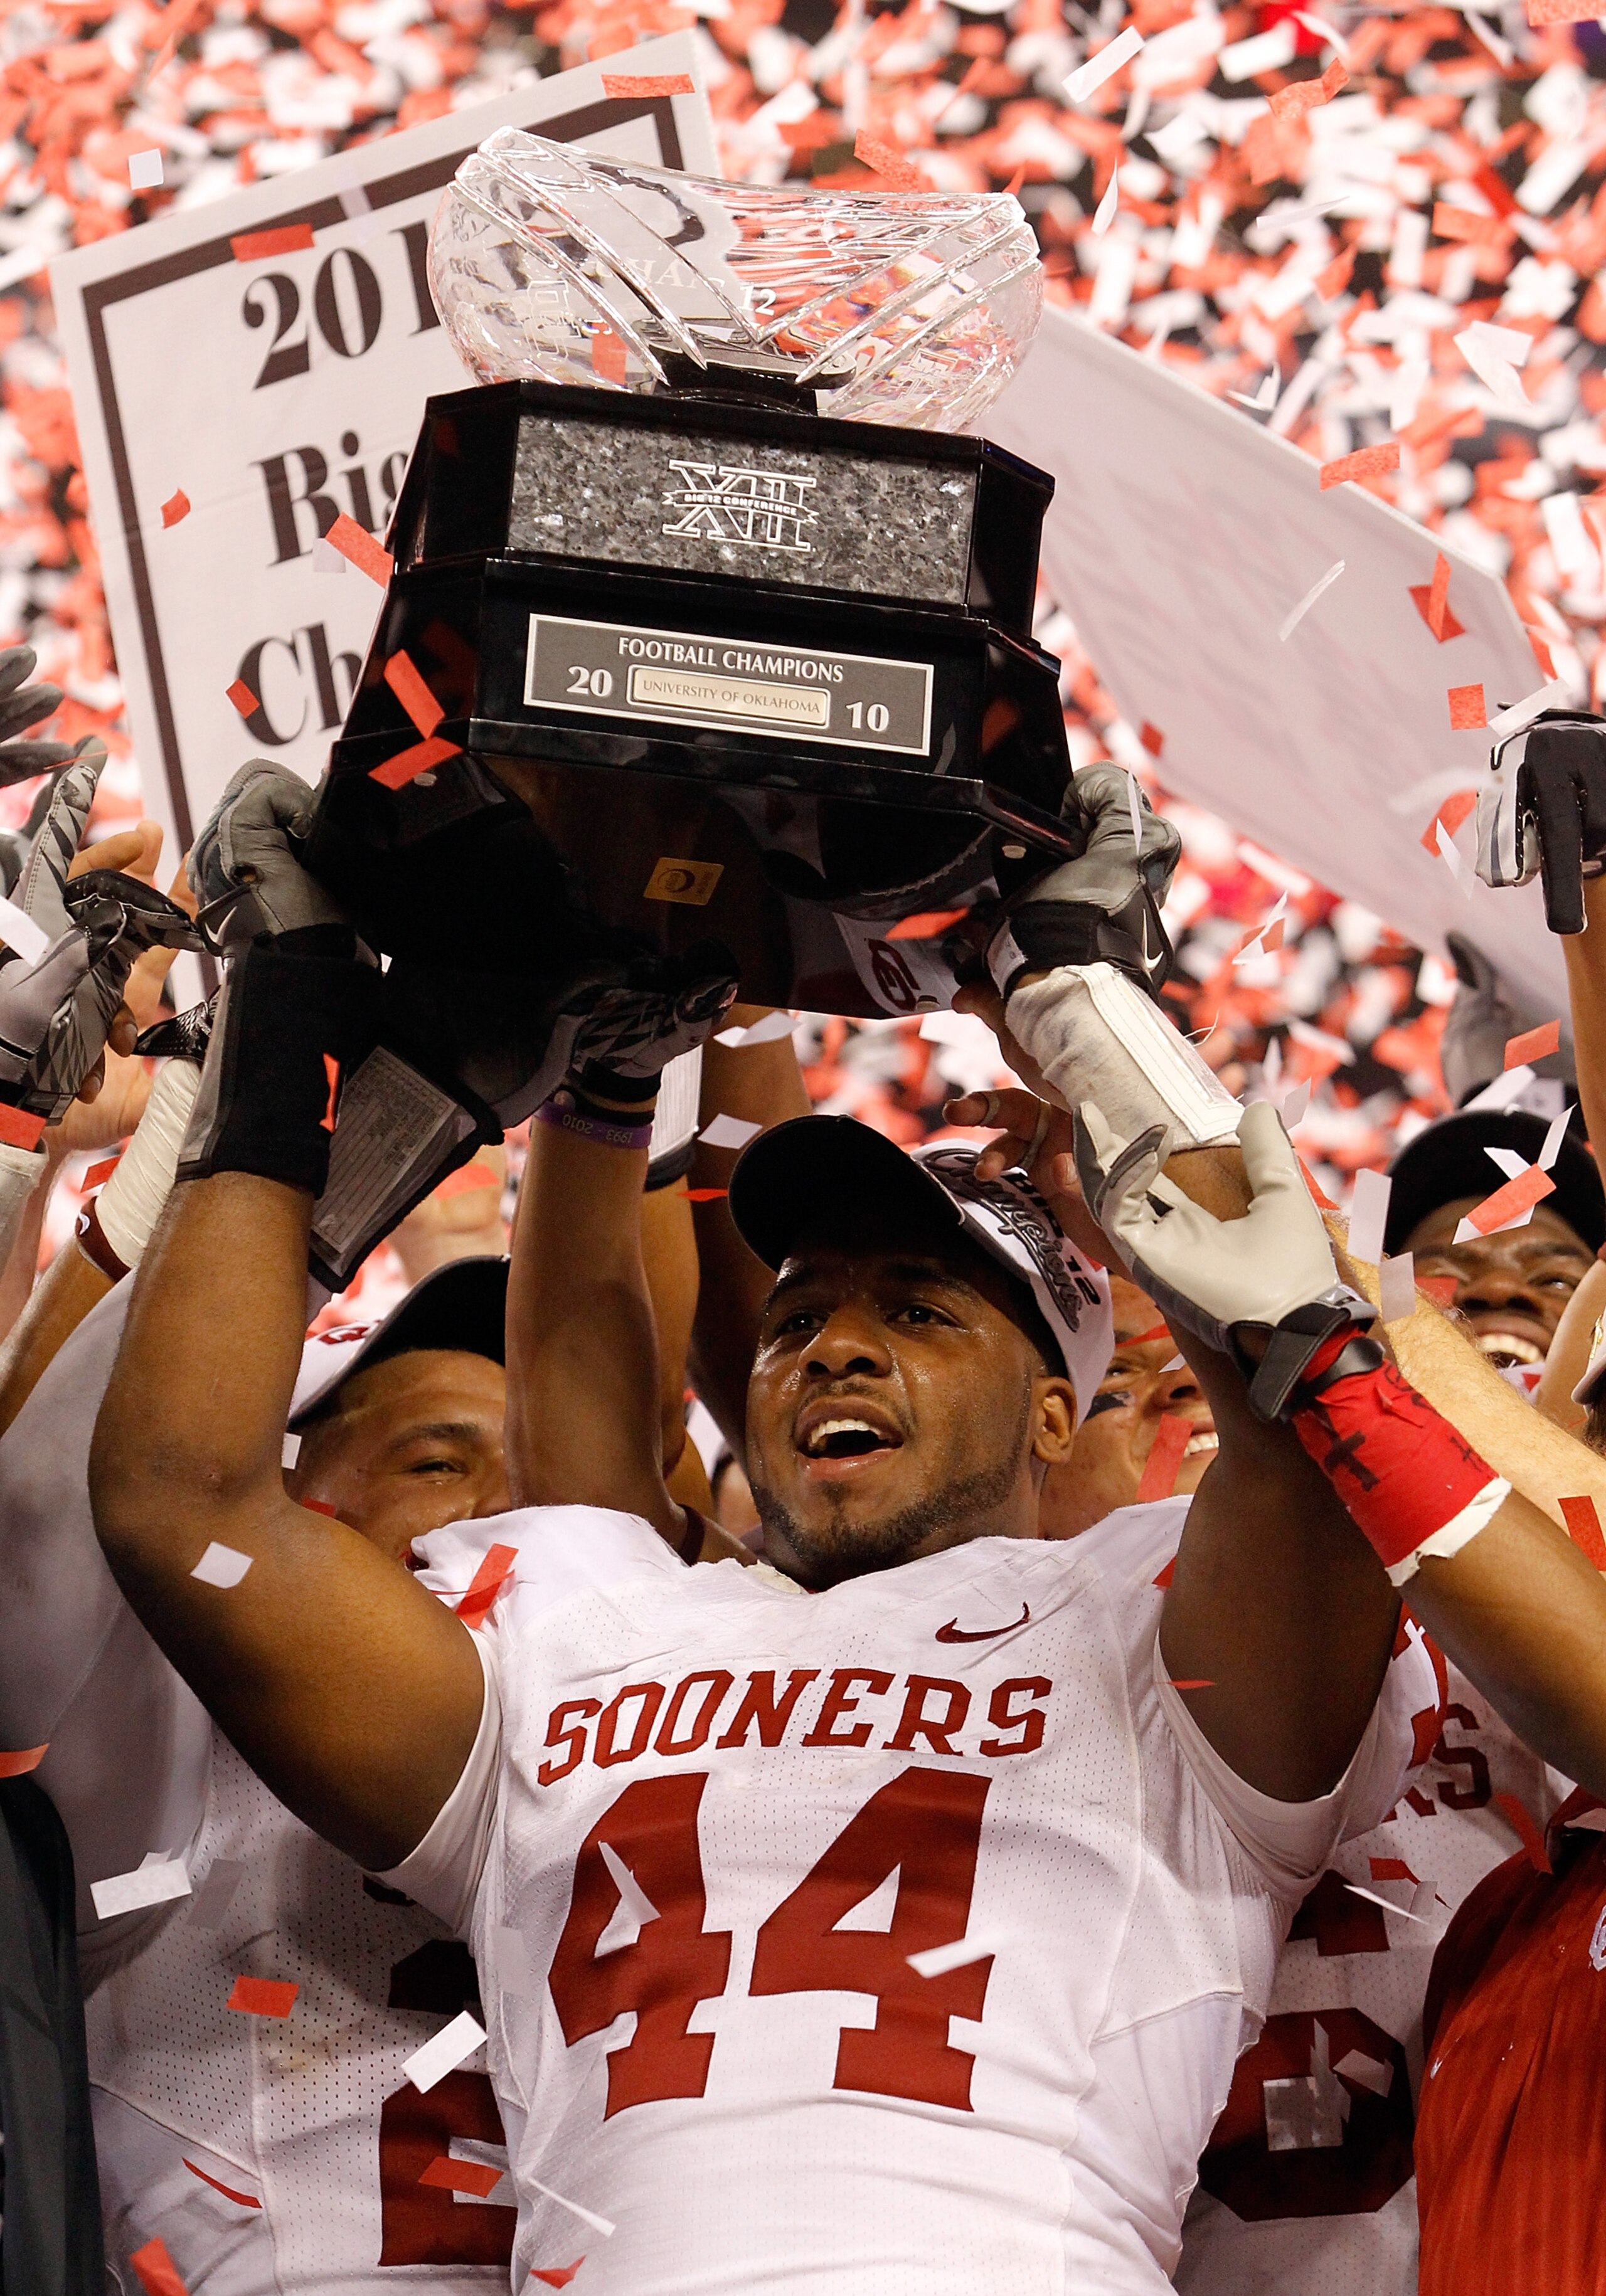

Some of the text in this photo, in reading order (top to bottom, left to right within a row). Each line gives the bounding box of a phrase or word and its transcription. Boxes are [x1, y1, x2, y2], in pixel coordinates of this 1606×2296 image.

[723, 495, 797, 516] CONFERENCE
[618, 636, 844, 682] FOOTBALL CHAMPIONS
[566, 665, 613, 697] 20
[643, 679, 820, 713] UNIVERSITY OF OKLAHOMA
[846, 701, 890, 732] 10
[562, 1114, 593, 1135] 2010
[1066, 1255, 1101, 1305] 12
[538, 1668, 1052, 1787] SOONERS
[547, 1766, 996, 2122] 44
